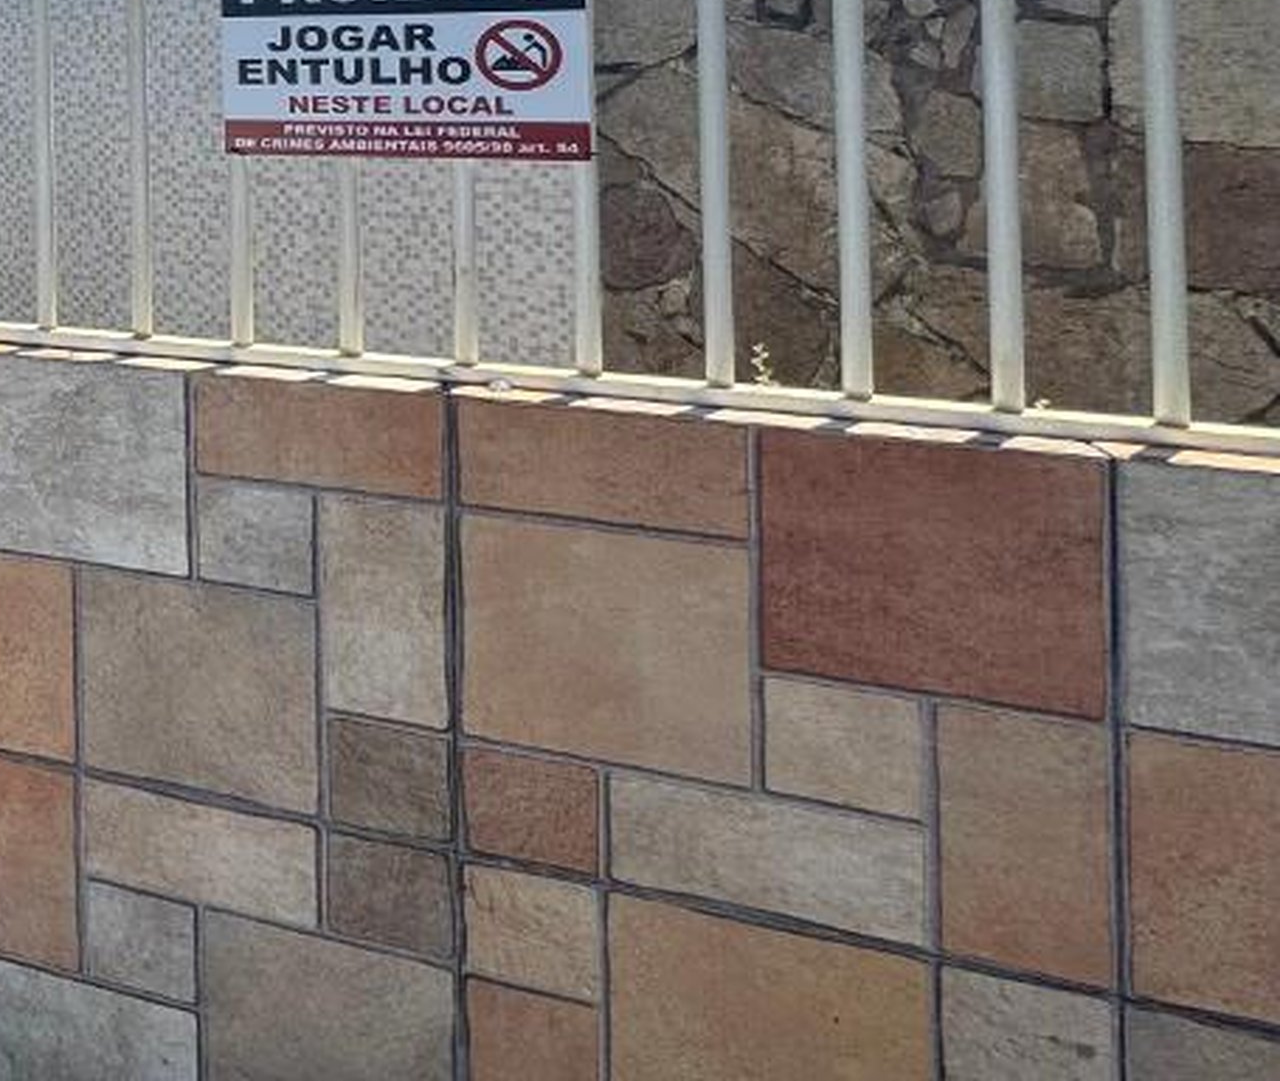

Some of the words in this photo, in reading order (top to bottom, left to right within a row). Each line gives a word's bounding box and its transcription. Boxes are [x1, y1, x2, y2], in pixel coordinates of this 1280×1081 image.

[267, 23, 436, 52] JOGAR
[238, 56, 472, 85] ENTULHO
[289, 95, 393, 115] NESTE
[404, 95, 513, 115] LOCAL
[283, 123, 368, 136] PREVISTO
[373, 125, 398, 136] NA
[403, 125, 432, 137] LEI
[438, 126, 521, 139] FEDERAL
[260, 138, 323, 150] CRIMES
[328, 138, 438, 152] AMBIENTAIS
